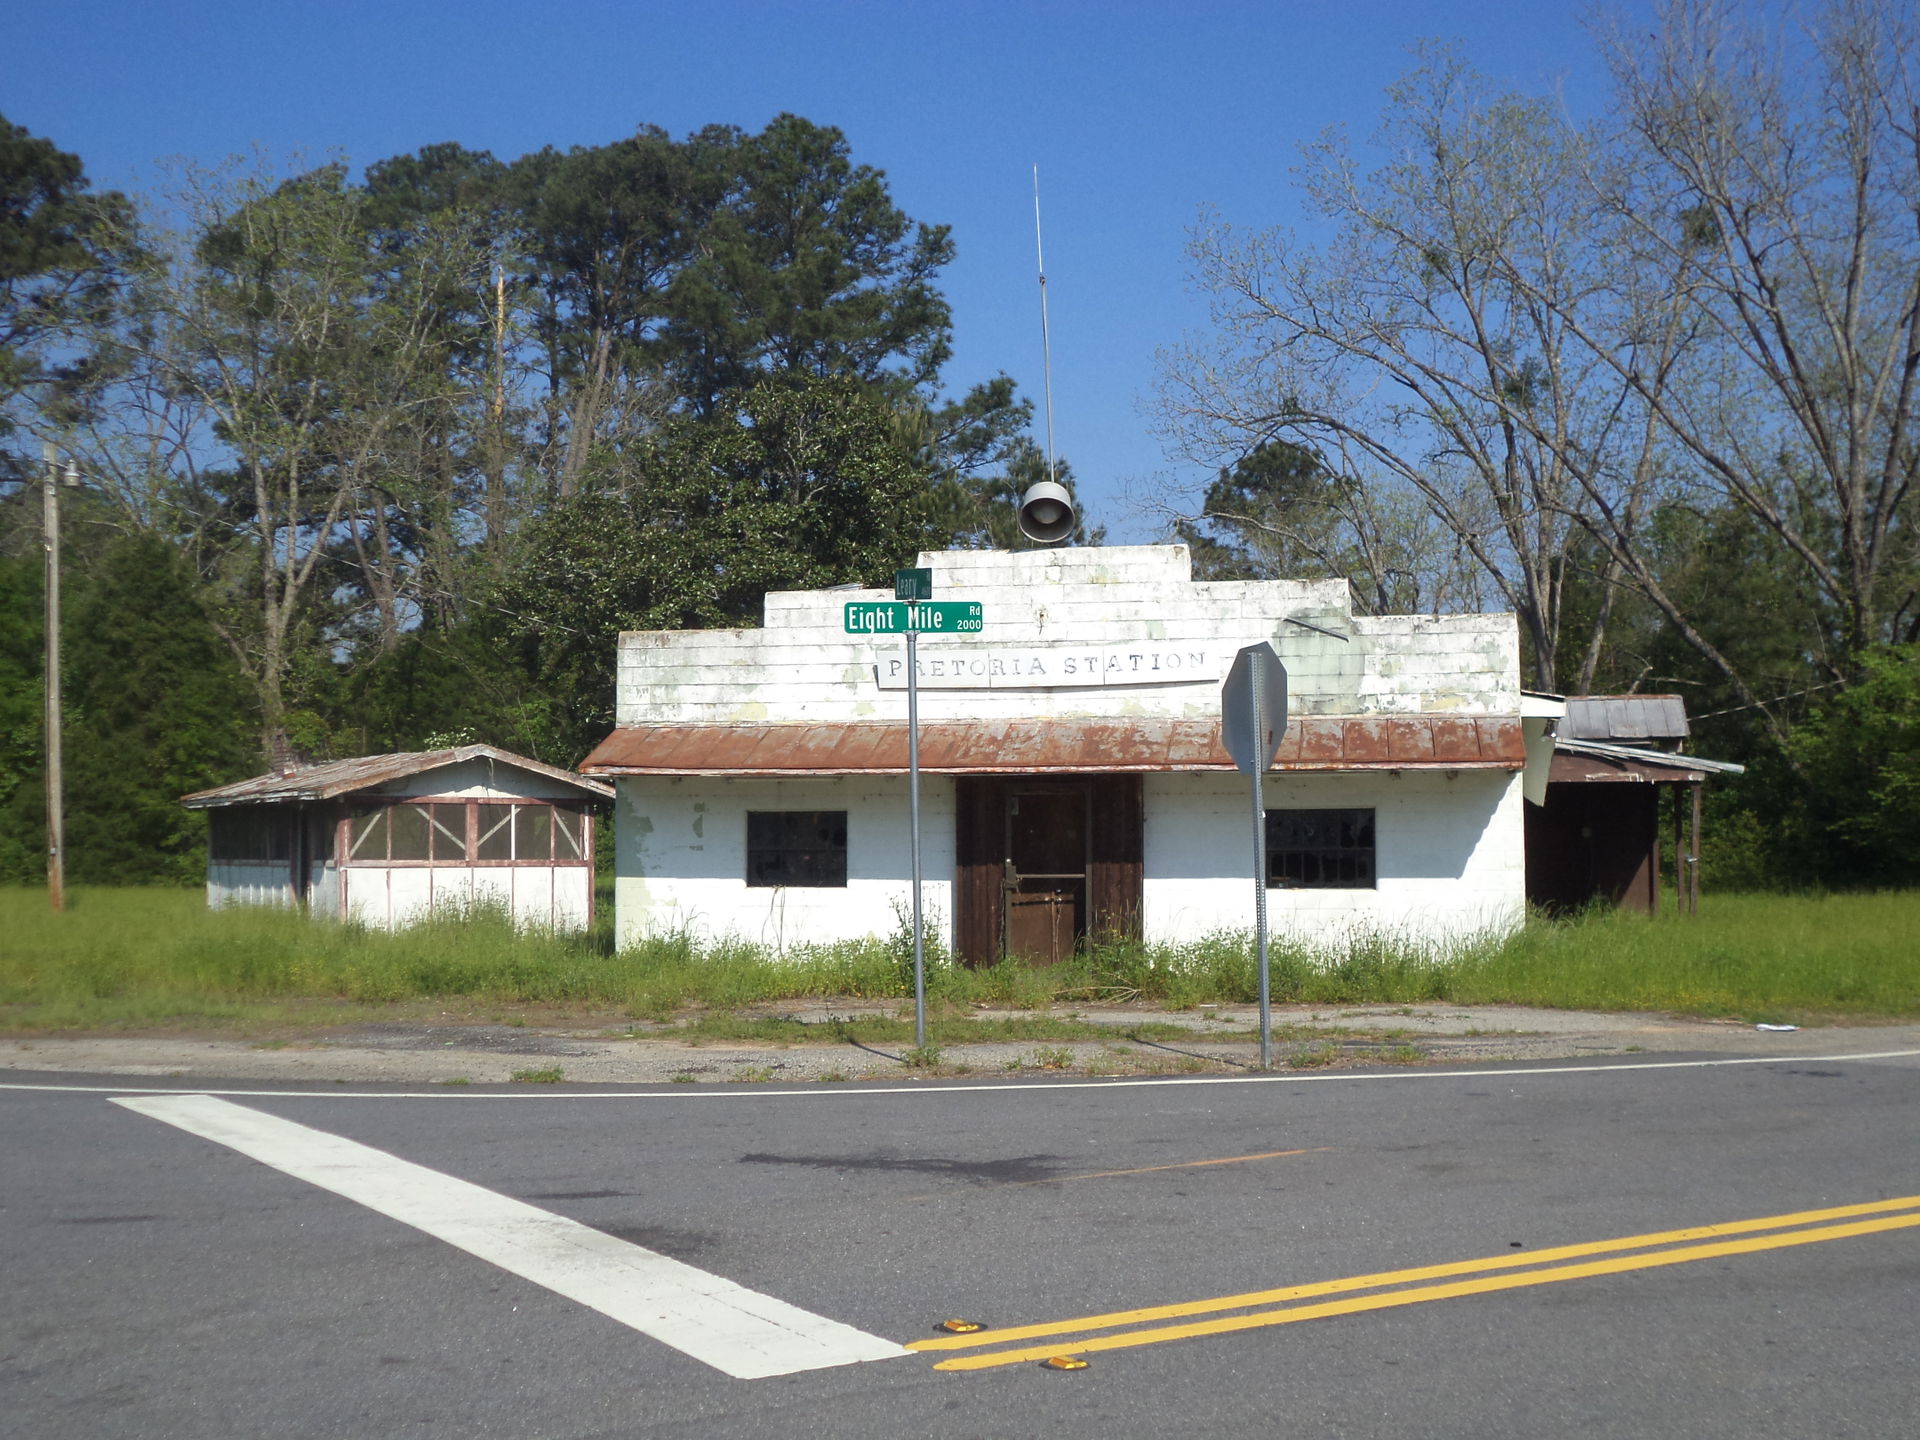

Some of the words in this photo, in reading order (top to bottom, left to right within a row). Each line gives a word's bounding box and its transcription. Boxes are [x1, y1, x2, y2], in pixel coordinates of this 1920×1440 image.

[897, 573, 918, 599] Leary
[848, 606, 894, 634] Eight
[907, 606, 943, 629] Mile
[969, 605, 981, 616] Rd
[957, 619, 981, 630] 2000
[888, 657, 1047, 677] PRETORIA
[1063, 651, 1206, 675] STATION
